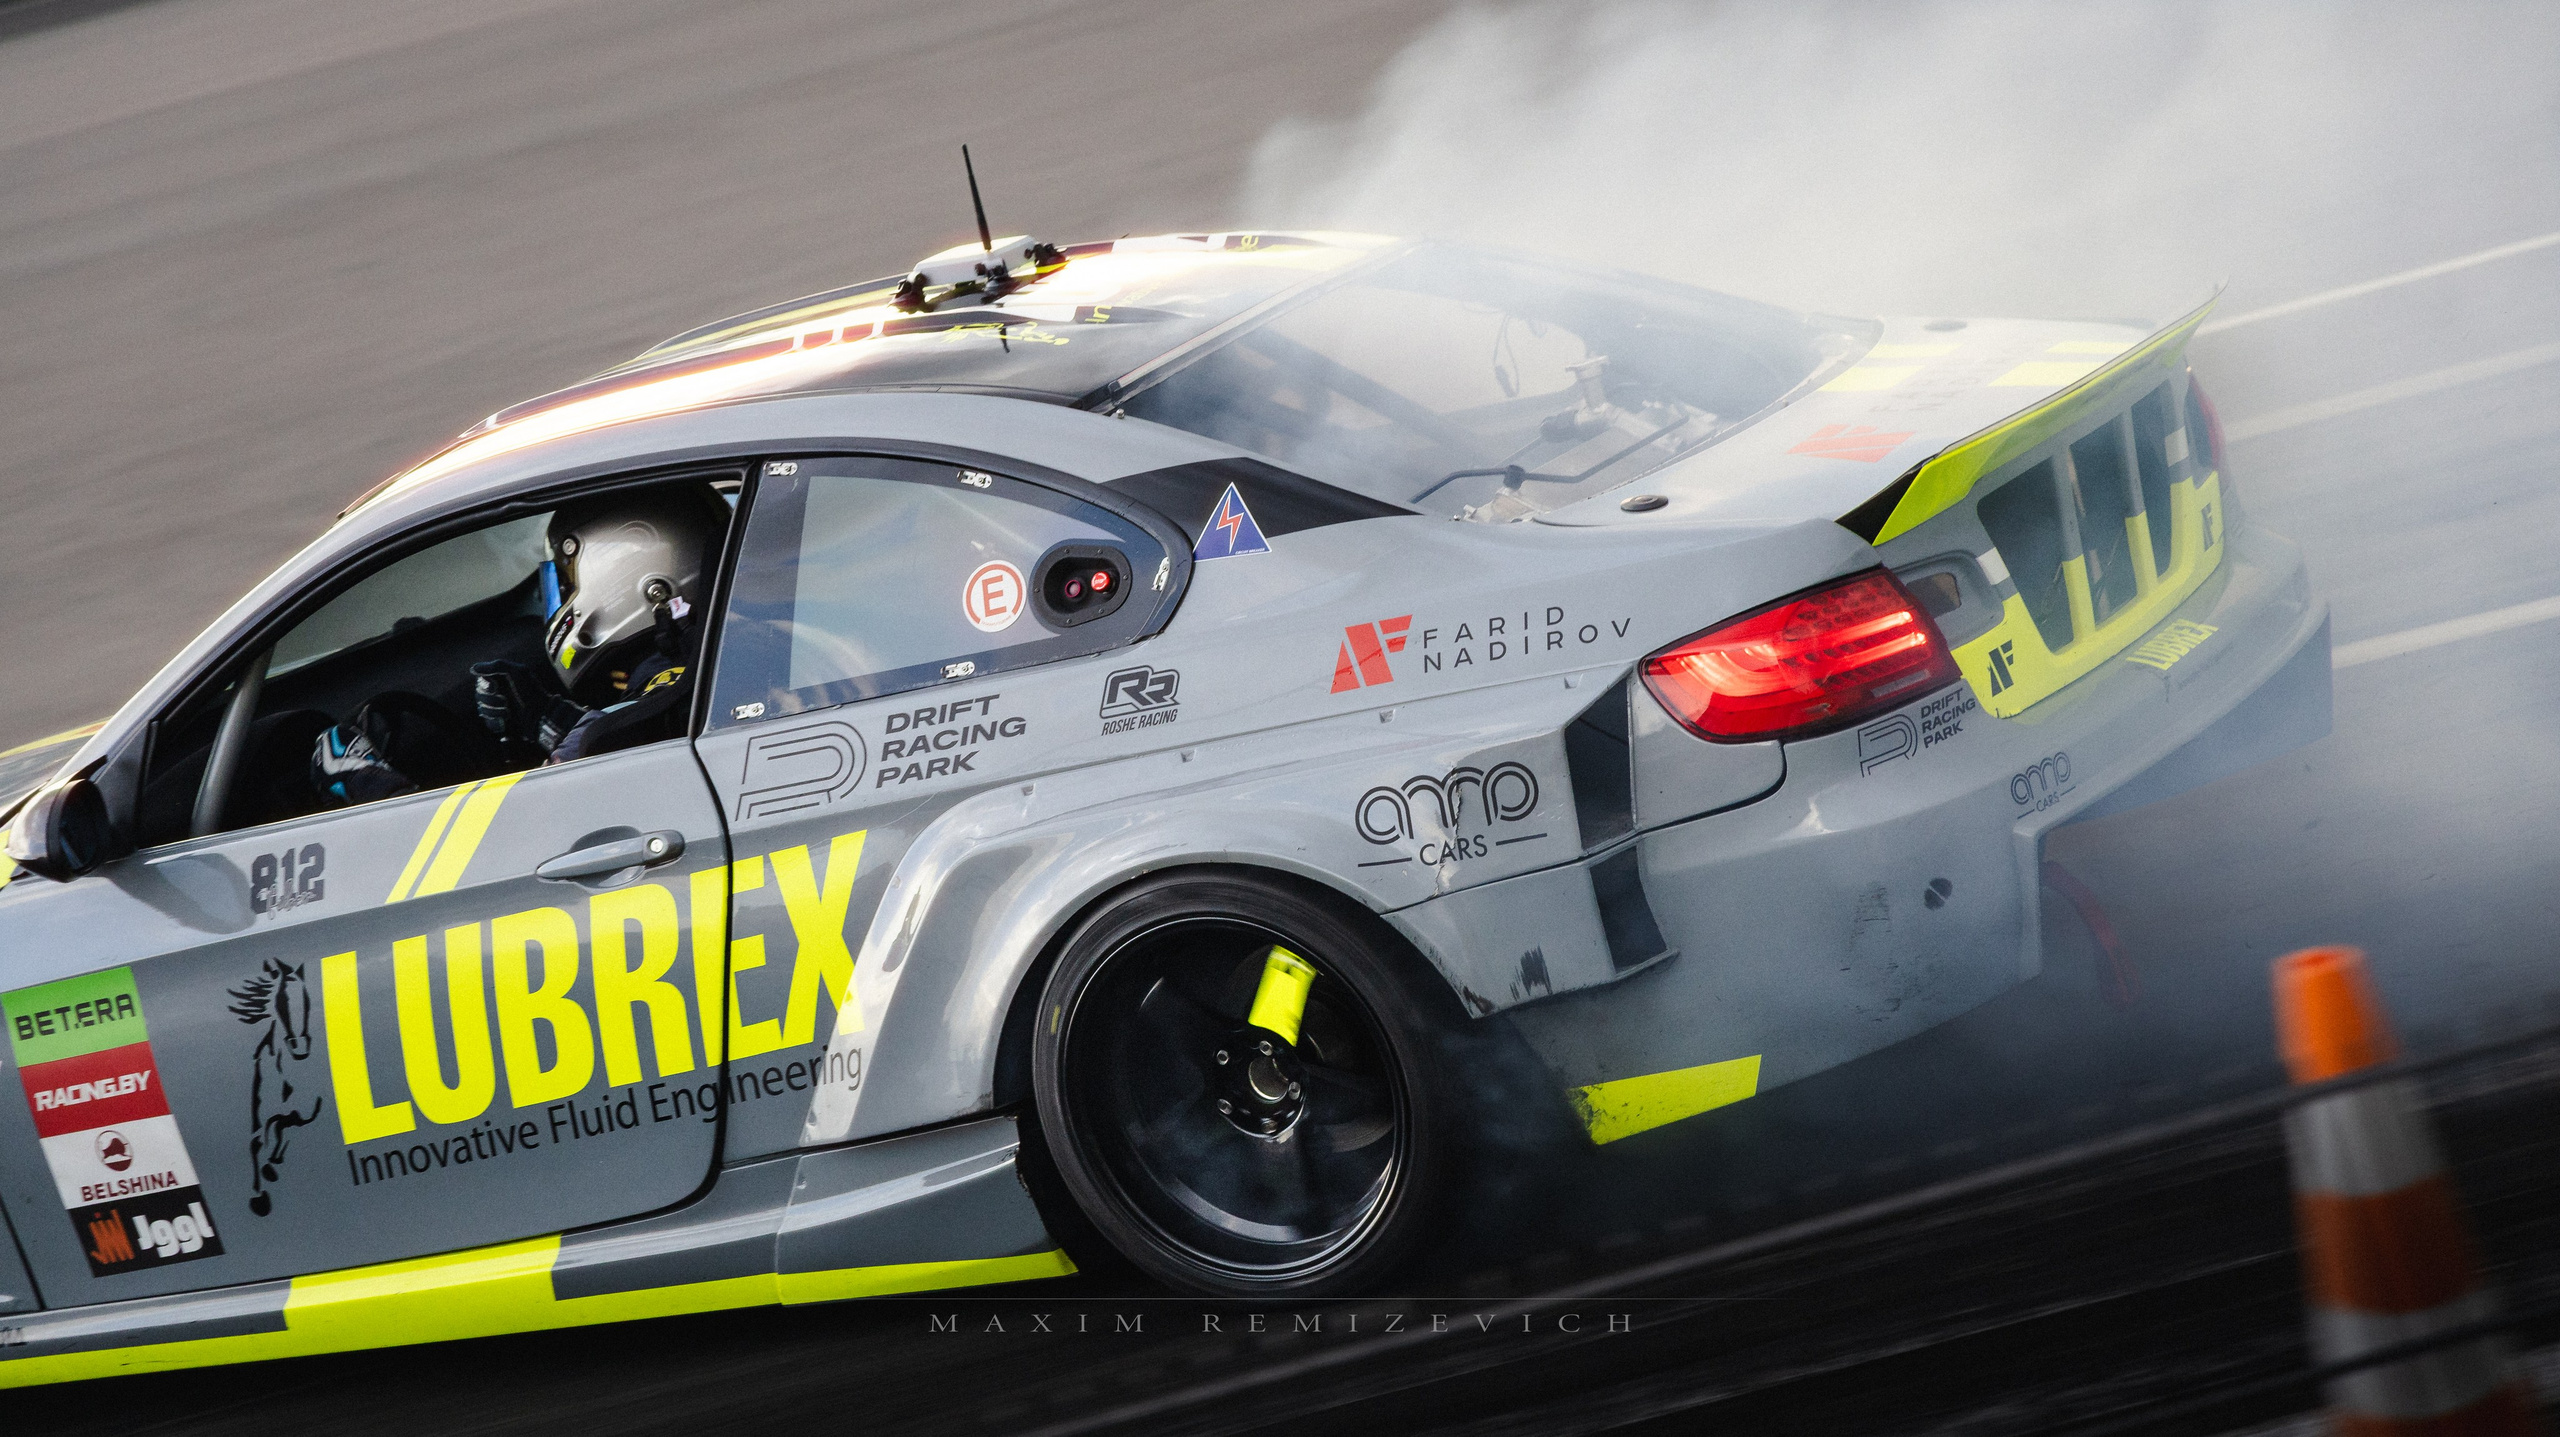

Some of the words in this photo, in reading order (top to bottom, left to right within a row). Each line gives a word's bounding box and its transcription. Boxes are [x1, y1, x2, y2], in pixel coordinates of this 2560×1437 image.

[982, 574, 1007, 618] E
[1423, 605, 1564, 649] FARID
[1423, 617, 1631, 673] NADIROV
[2125, 618, 2219, 671] LUBREX
[885, 693, 1000, 735] DRIFT
[1101, 716, 1138, 736] ROSHE
[1138, 708, 1178, 729] RACING
[1920, 688, 1964, 719] DRIFT
[1921, 698, 1976, 734] RACING
[881, 716, 1027, 762] RACING
[1923, 720, 1964, 749] PARK
[876, 750, 980, 789] PARK
[2036, 791, 2061, 812] CARS
[1419, 834, 1488, 866] CARS
[250, 842, 325, 915] 812
[321, 829, 868, 1145] LUBREX
[347, 1119, 540, 1187] Innovative
[547, 1087, 640, 1143] Fluid
[649, 1045, 862, 1123] Engineering
[81, 1170, 179, 1202] BELSHINA
